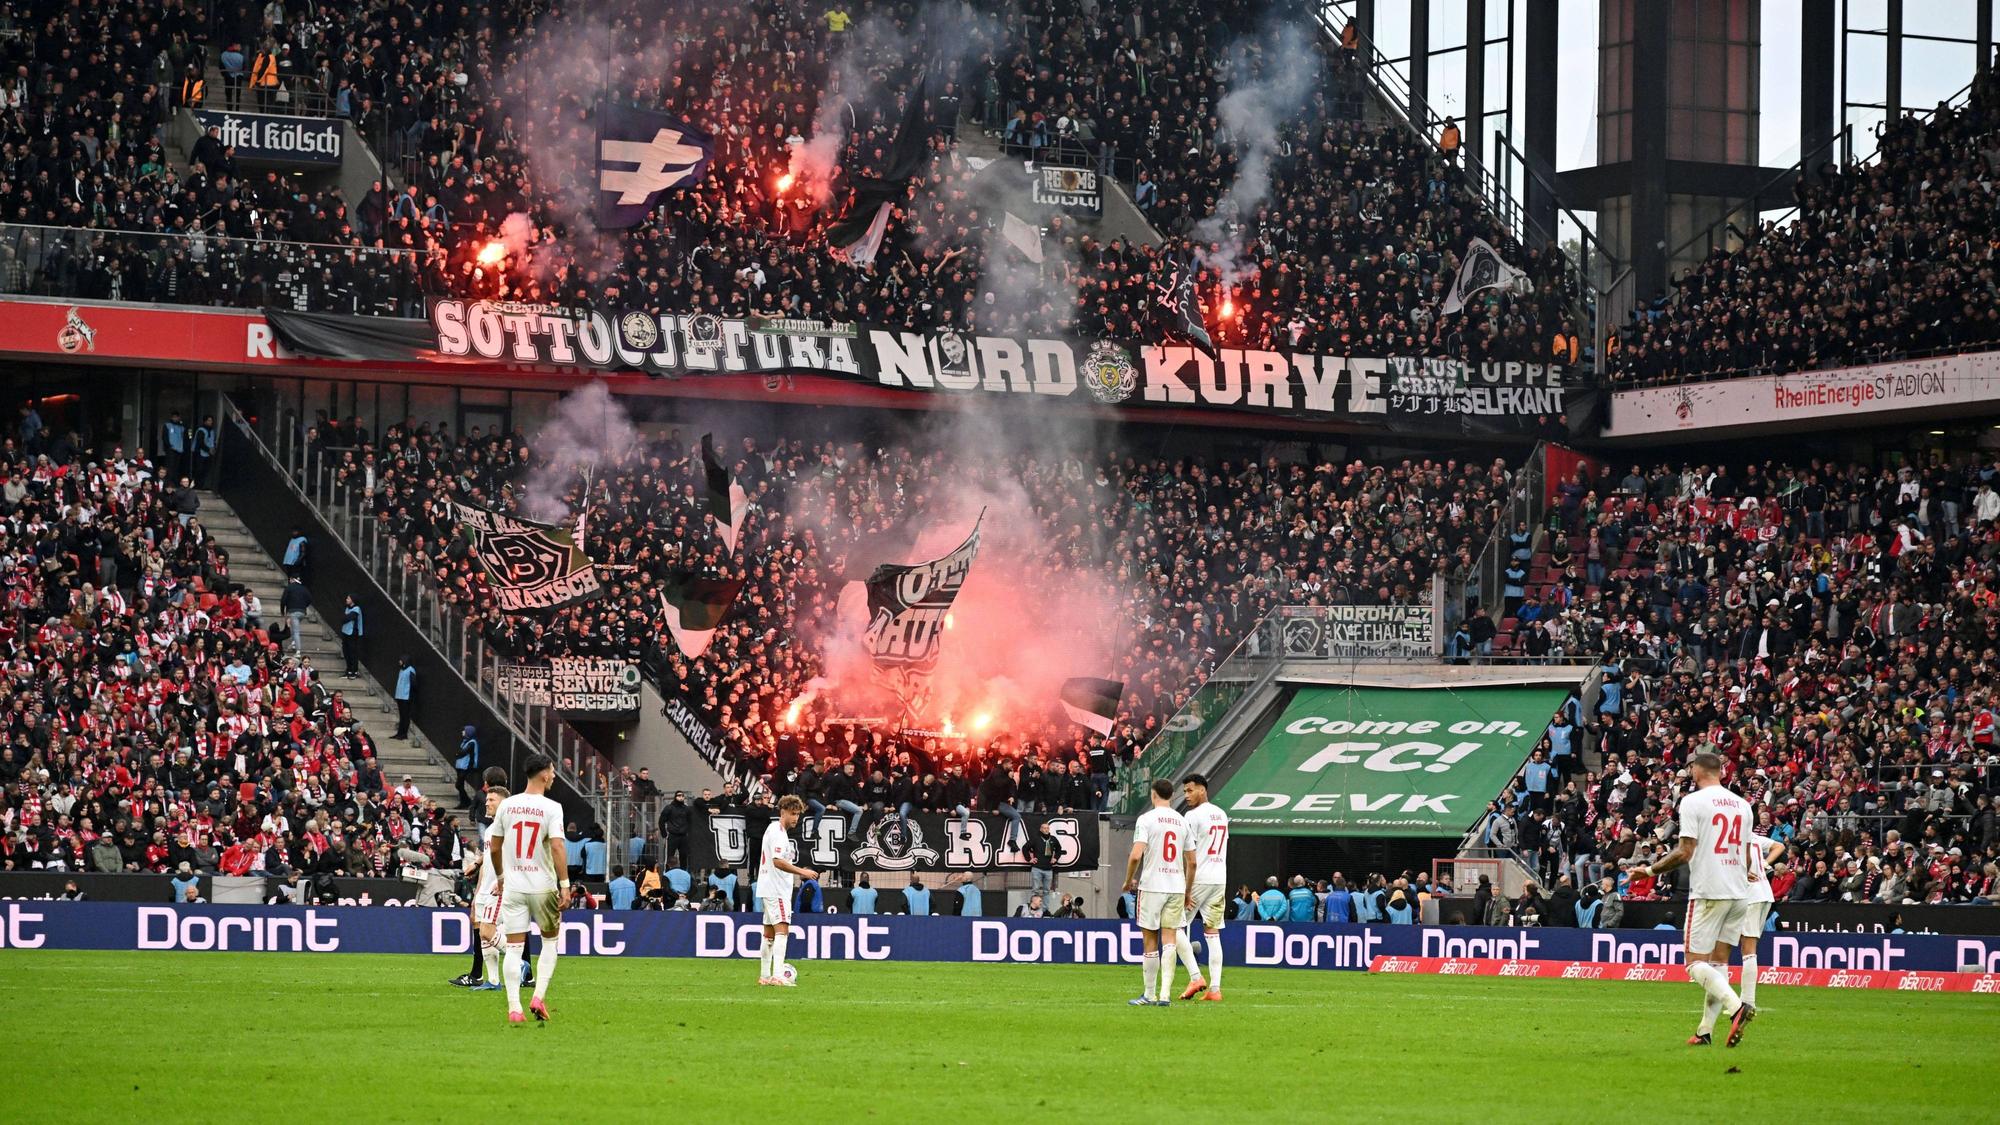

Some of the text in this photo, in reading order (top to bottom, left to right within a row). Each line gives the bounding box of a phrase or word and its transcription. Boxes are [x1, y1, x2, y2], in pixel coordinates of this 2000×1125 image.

[869, 330, 1077, 396] NORD
[1140, 345, 1387, 414] KURVE
[1396, 376, 1458, 396] CREW
[1460, 387, 1565, 416] SELFKANT
[551, 657, 626, 676] BEGLEIT
[552, 675, 623, 693] SERVICE
[1285, 716, 1529, 738] Come on,
[1296, 741, 1483, 774] FC!
[507, 806, 545, 819] PACARADA
[1230, 793, 1461, 814] DEVK
[1158, 816, 1182, 827] MARTEL
[1291, 818, 1348, 827] Getan.
[1355, 818, 1442, 828] Geholfen.
[1712, 812, 1743, 856] 24
[512, 820, 541, 860] 17
[1163, 830, 1177, 863] 6
[1207, 825, 1227, 856] 27
[137, 906, 340, 952] Dorint
[972, 920, 1145, 964] Dorint
[1245, 924, 1382, 968] Dorint
